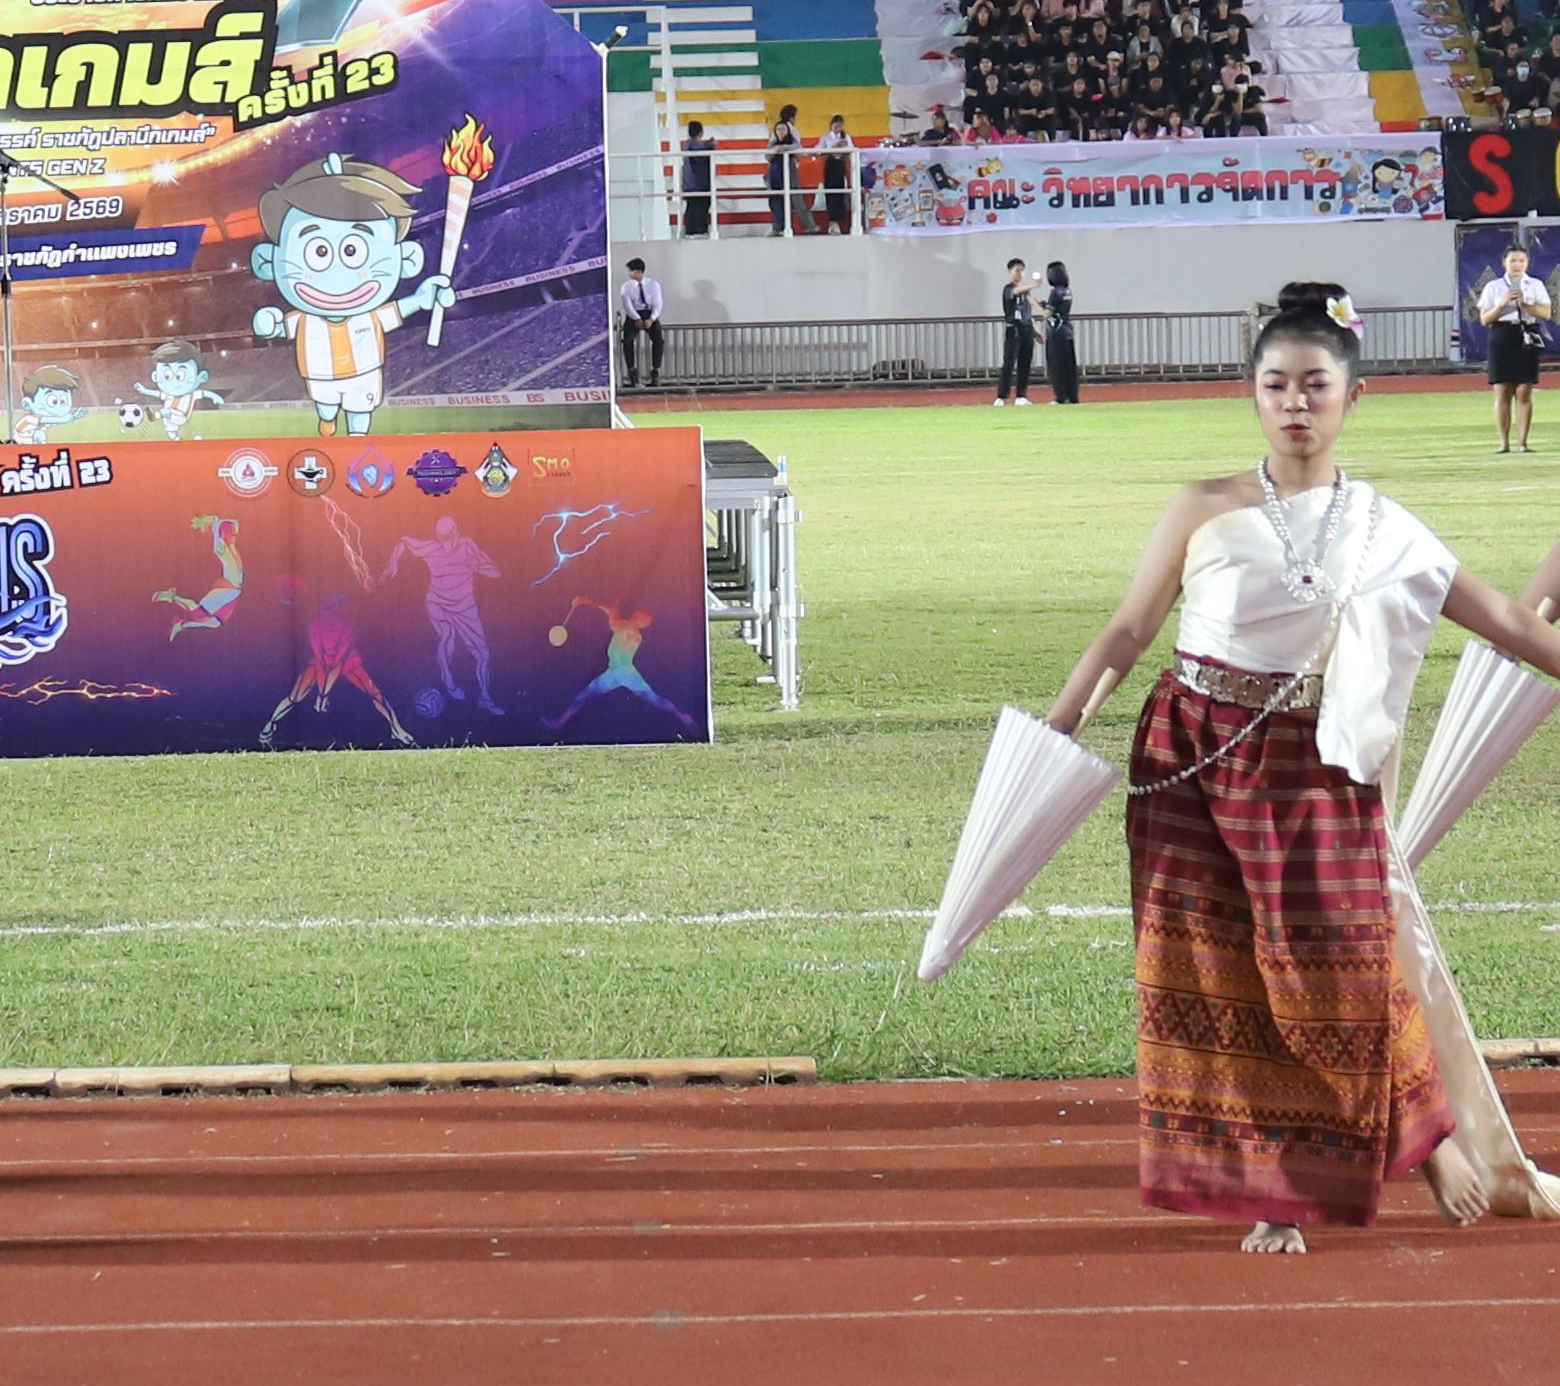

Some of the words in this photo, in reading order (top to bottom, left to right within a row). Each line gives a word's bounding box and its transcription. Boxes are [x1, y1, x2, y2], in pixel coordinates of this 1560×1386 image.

[344, 51, 397, 95] 23
[47, 159, 87, 176] GEN
[66, 196, 123, 221] 2569
[447, 393, 511, 406] BUSINESS
[79, 458, 113, 485] 23
